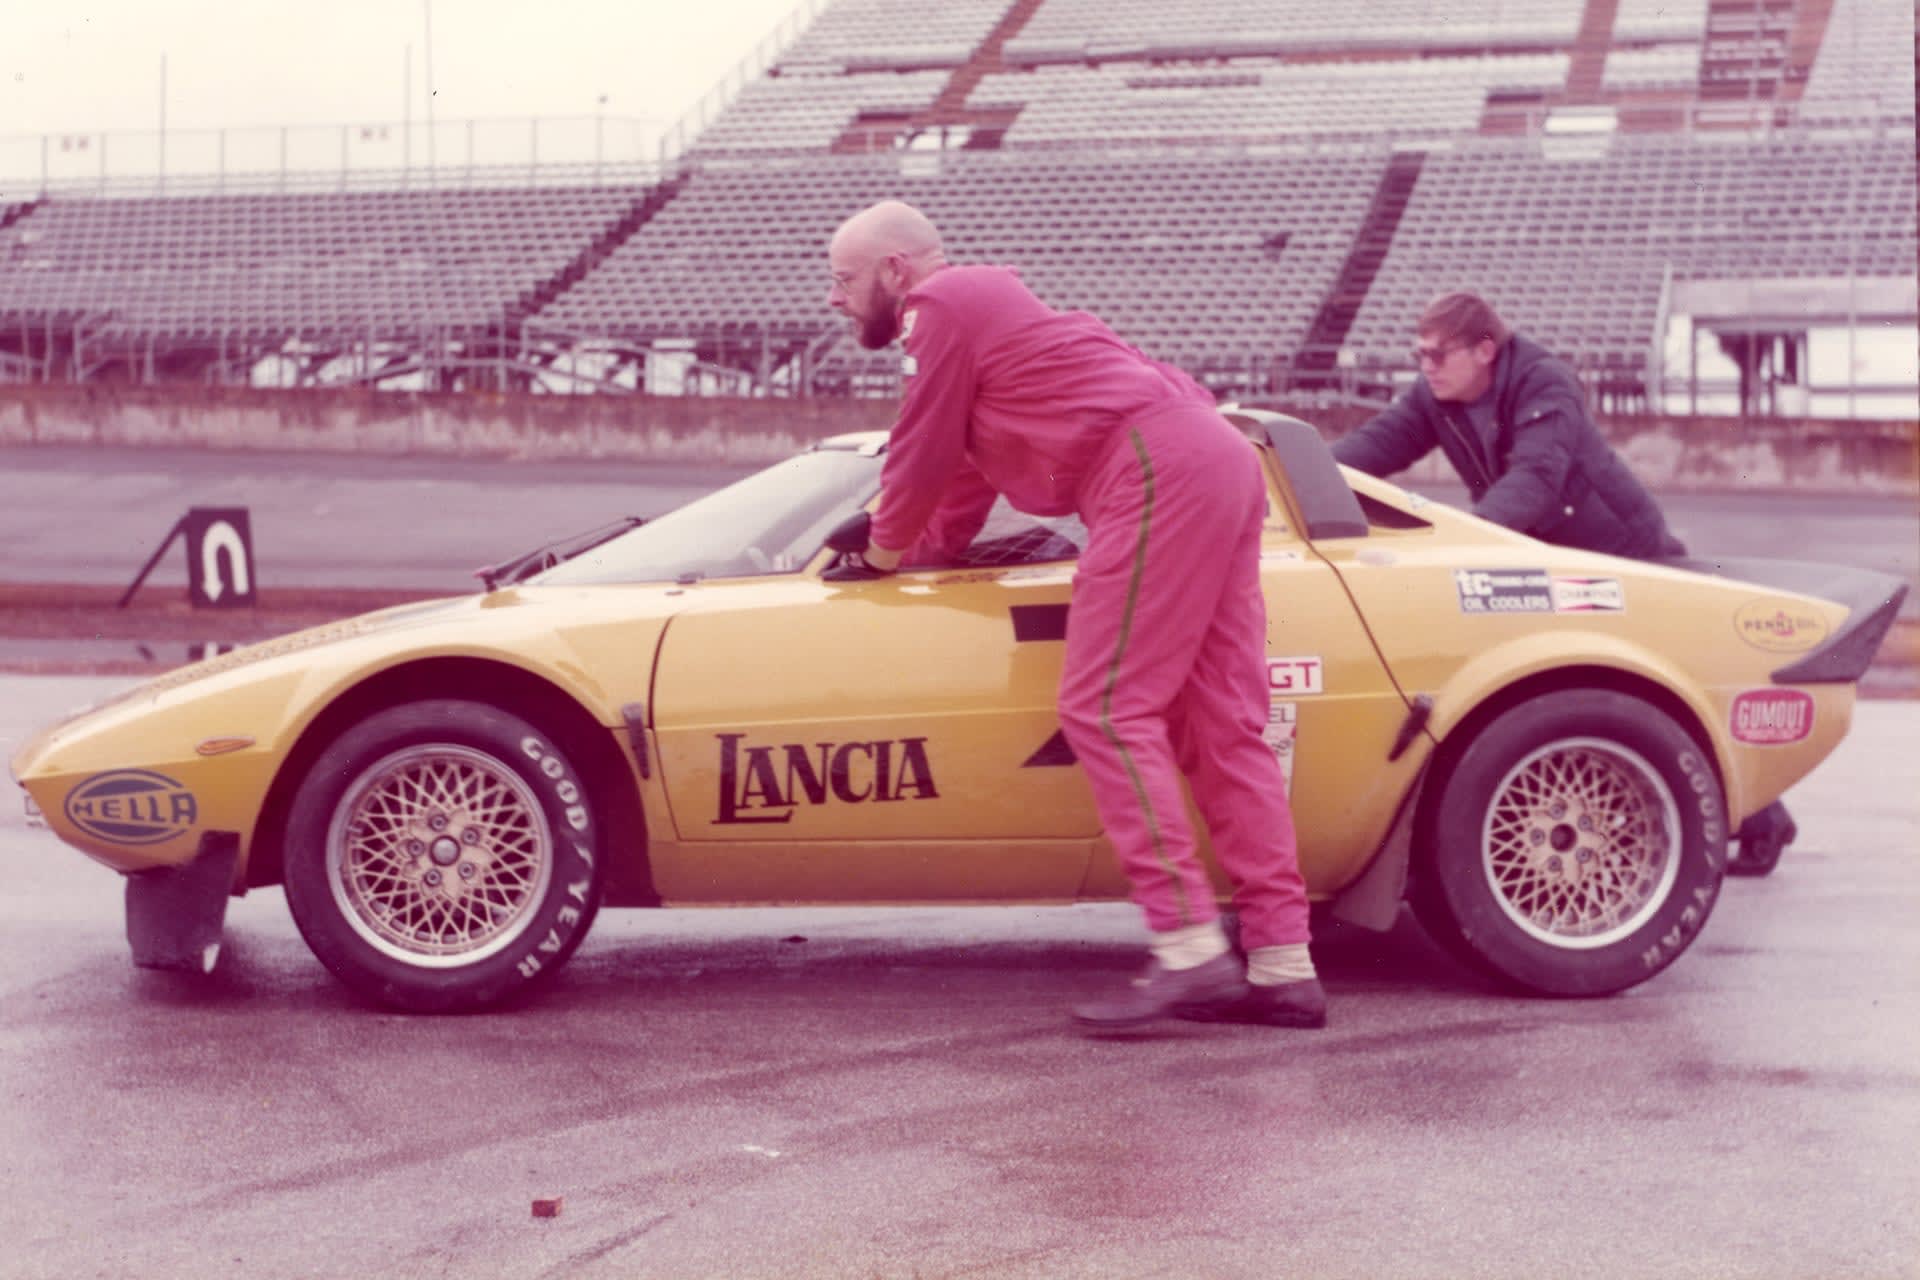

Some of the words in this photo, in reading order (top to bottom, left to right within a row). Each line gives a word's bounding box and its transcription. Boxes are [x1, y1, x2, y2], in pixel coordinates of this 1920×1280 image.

[1268, 661, 1319, 689] GT
[1738, 700, 1806, 730] GUMOUT
[709, 733, 941, 825] LANCIA
[73, 793, 197, 825] HELLA
